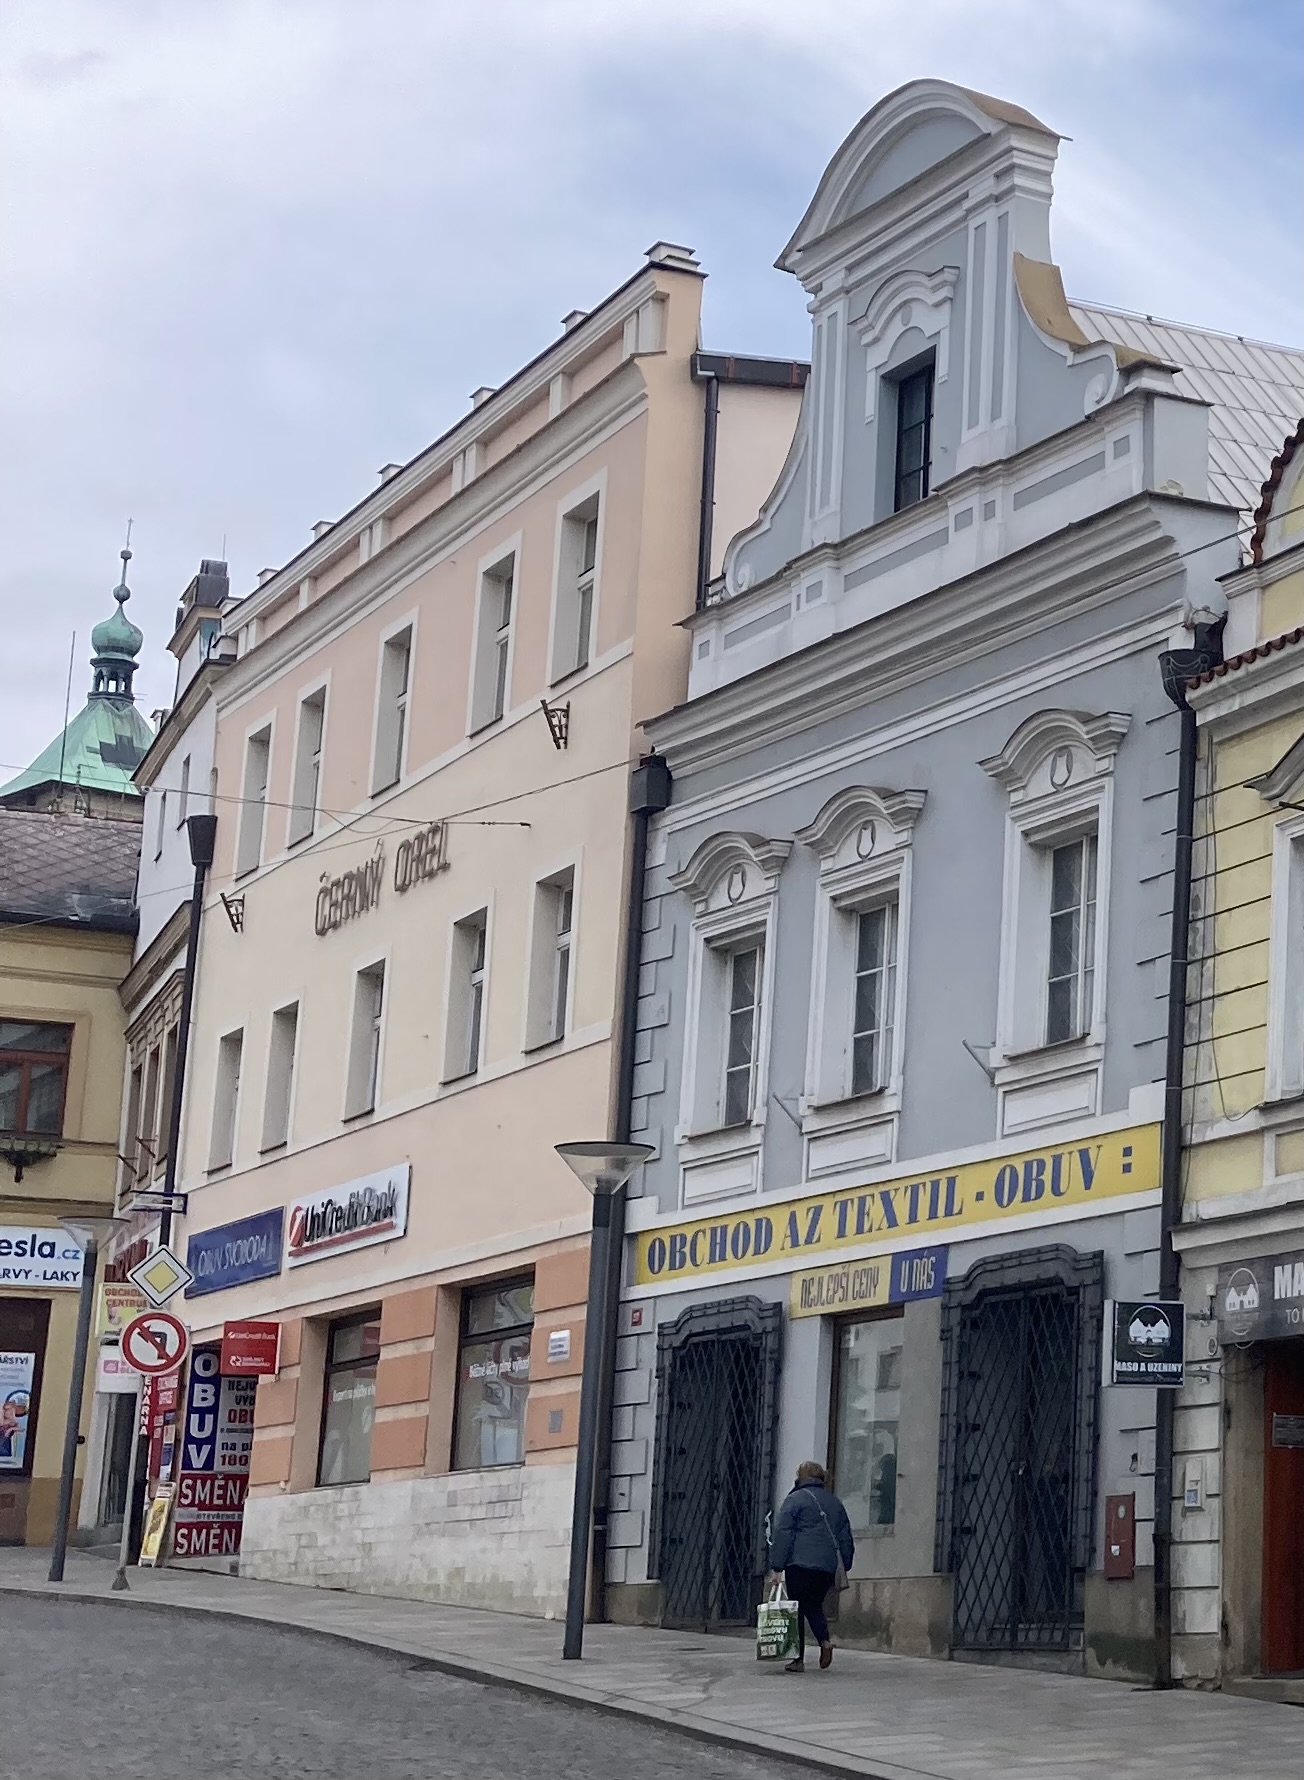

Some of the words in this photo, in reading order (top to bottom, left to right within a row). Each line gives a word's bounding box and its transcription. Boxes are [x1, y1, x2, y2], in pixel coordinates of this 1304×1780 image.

[394, 819, 451, 892] OREL
[647, 1216, 773, 1275] OBCHOD
[780, 1204, 824, 1250] AZ
[832, 1175, 964, 1239] TEXTIL
[994, 1145, 1103, 1208] OBUV
[0, 1268, 33, 1280] RVY
[43, 1269, 81, 1282] LAKY
[800, 1264, 850, 1309] NEJLEPŠÍ
[852, 1266, 880, 1301] CENY
[901, 1260, 909, 1293] U
[912, 1249, 936, 1291] NÁS
[1114, 1360, 1139, 1372] MASO
[1140, 1362, 1147, 1372] A
[189, 1352, 219, 1469] OBUV
[175, 1522, 240, 1556] SMĚN
